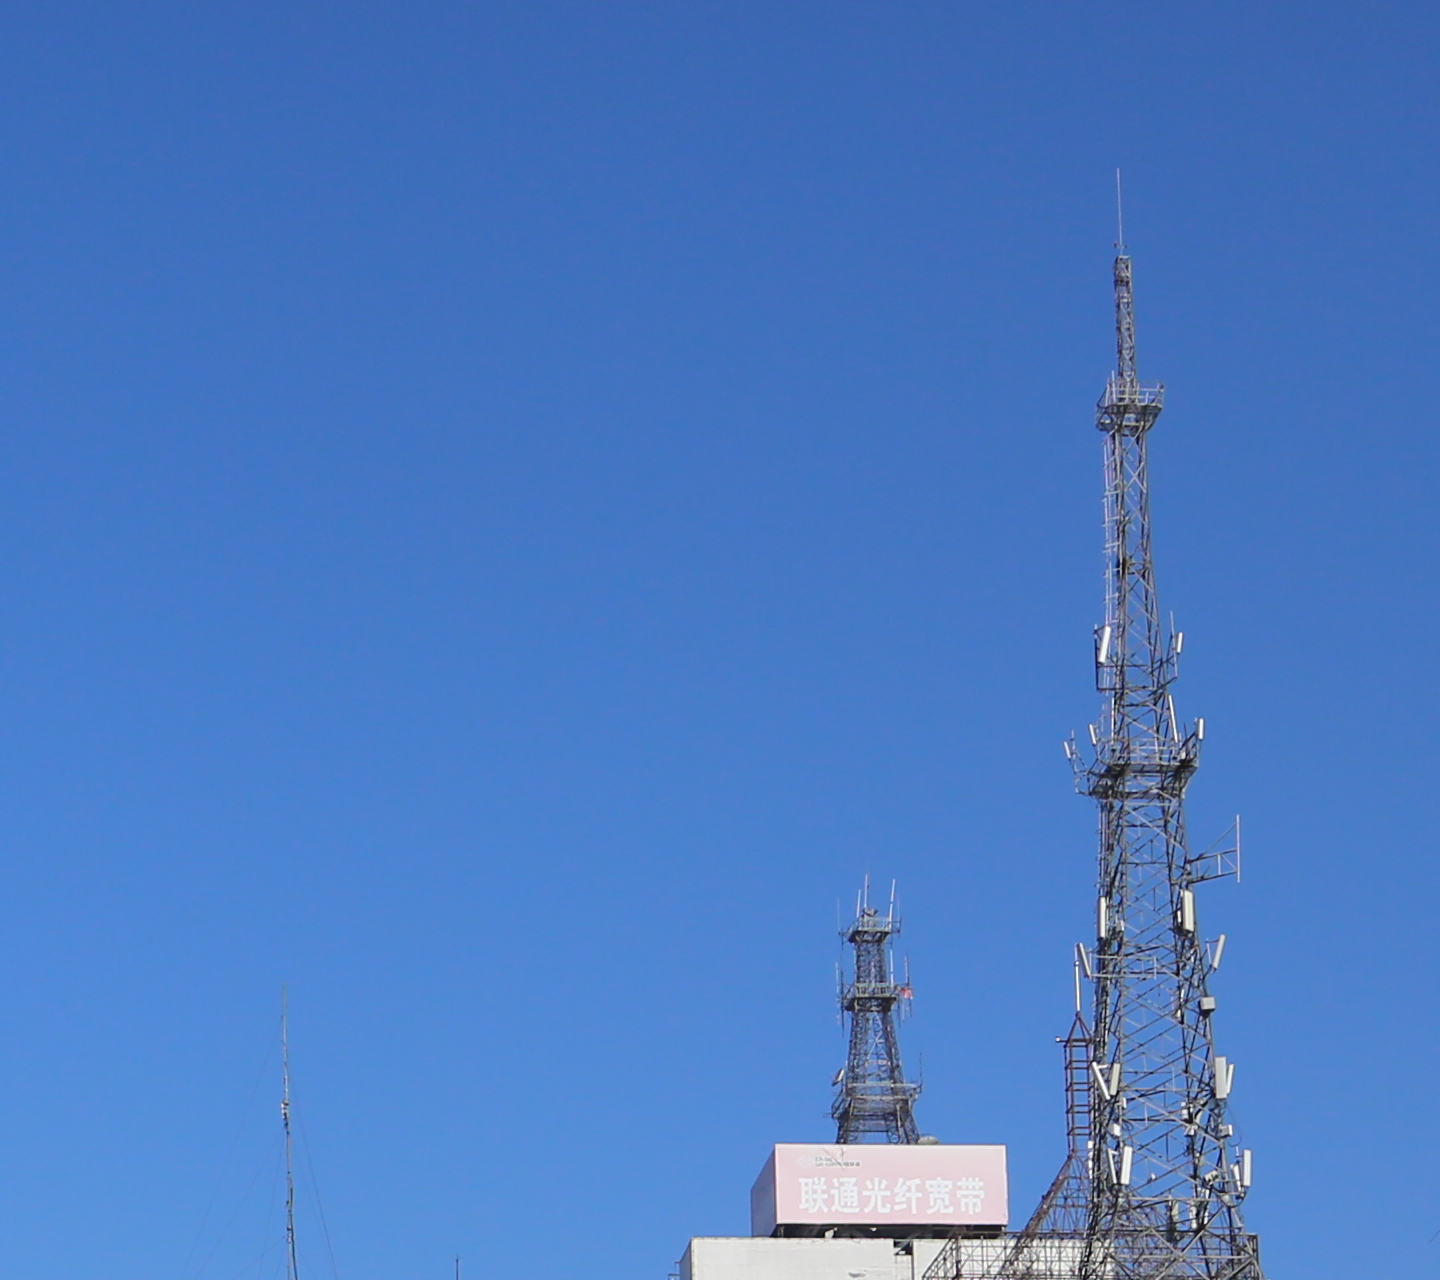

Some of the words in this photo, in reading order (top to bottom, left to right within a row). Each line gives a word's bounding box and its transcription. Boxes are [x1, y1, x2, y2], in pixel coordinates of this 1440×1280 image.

[798, 1177, 985, 1215] 联通光纤宽带
